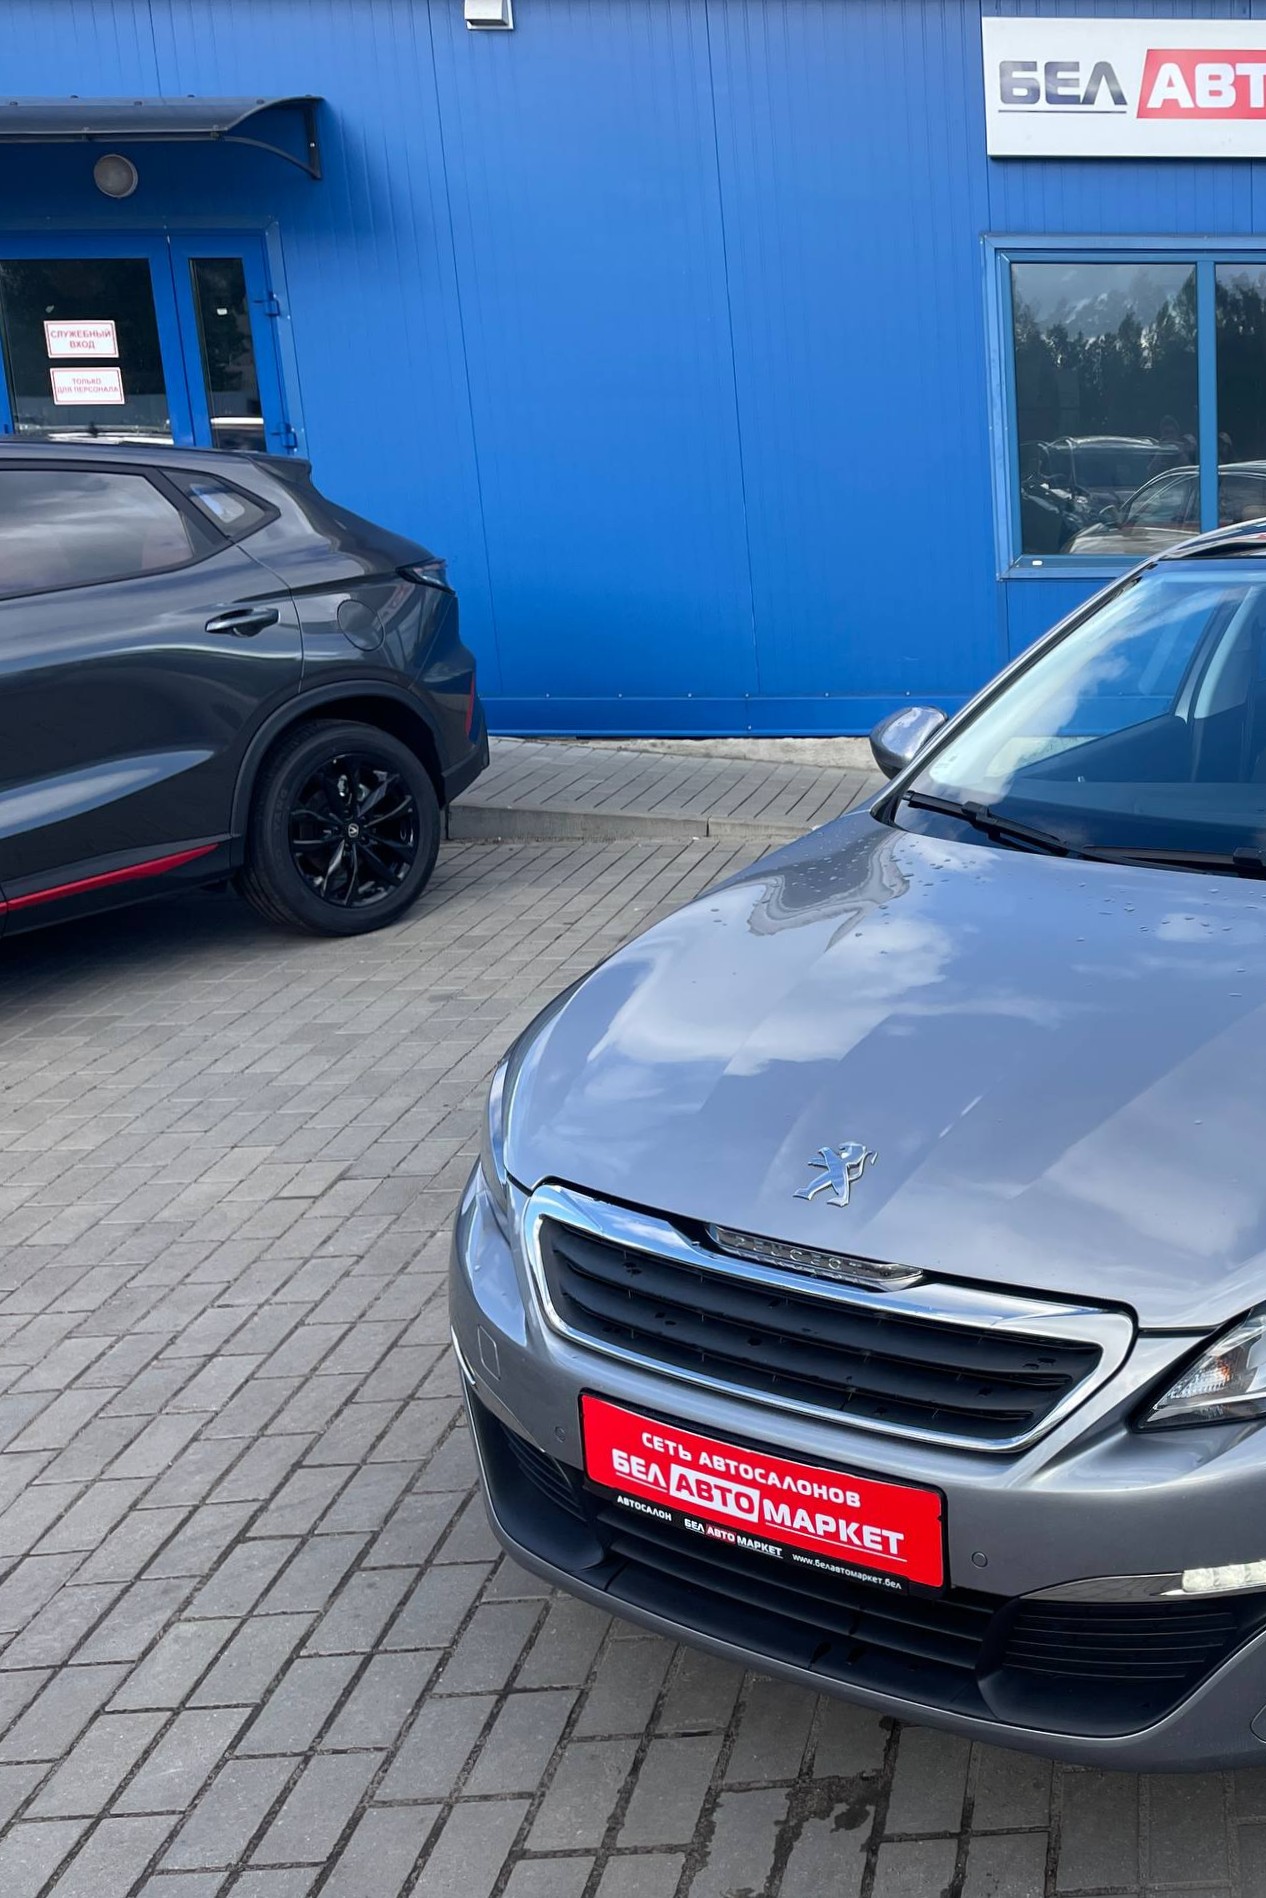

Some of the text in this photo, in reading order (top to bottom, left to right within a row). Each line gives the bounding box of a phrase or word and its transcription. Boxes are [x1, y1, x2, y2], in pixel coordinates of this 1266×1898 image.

[998, 60, 1128, 106] БЕЛ
[50, 328, 112, 339] СЛУЖЕБНЫЙ
[69, 340, 96, 350] ВХОД
[71, 377, 102, 386] ТОЛЬКО
[73, 385, 119, 394] ПЕРСОНАЛА
[641, 1431, 862, 1508] СЕТЬ АВТОСАЛОНОВ
[611, 1448, 905, 1555] БЕЛ АВТО МАРКЕТ
[617, 1495, 673, 1522] АВТОСАЛОН
[683, 1518, 783, 1556] БЕЛ АВТО МАРКЕТ
[791, 1553, 902, 1590] www.белавтомаркет.бел
